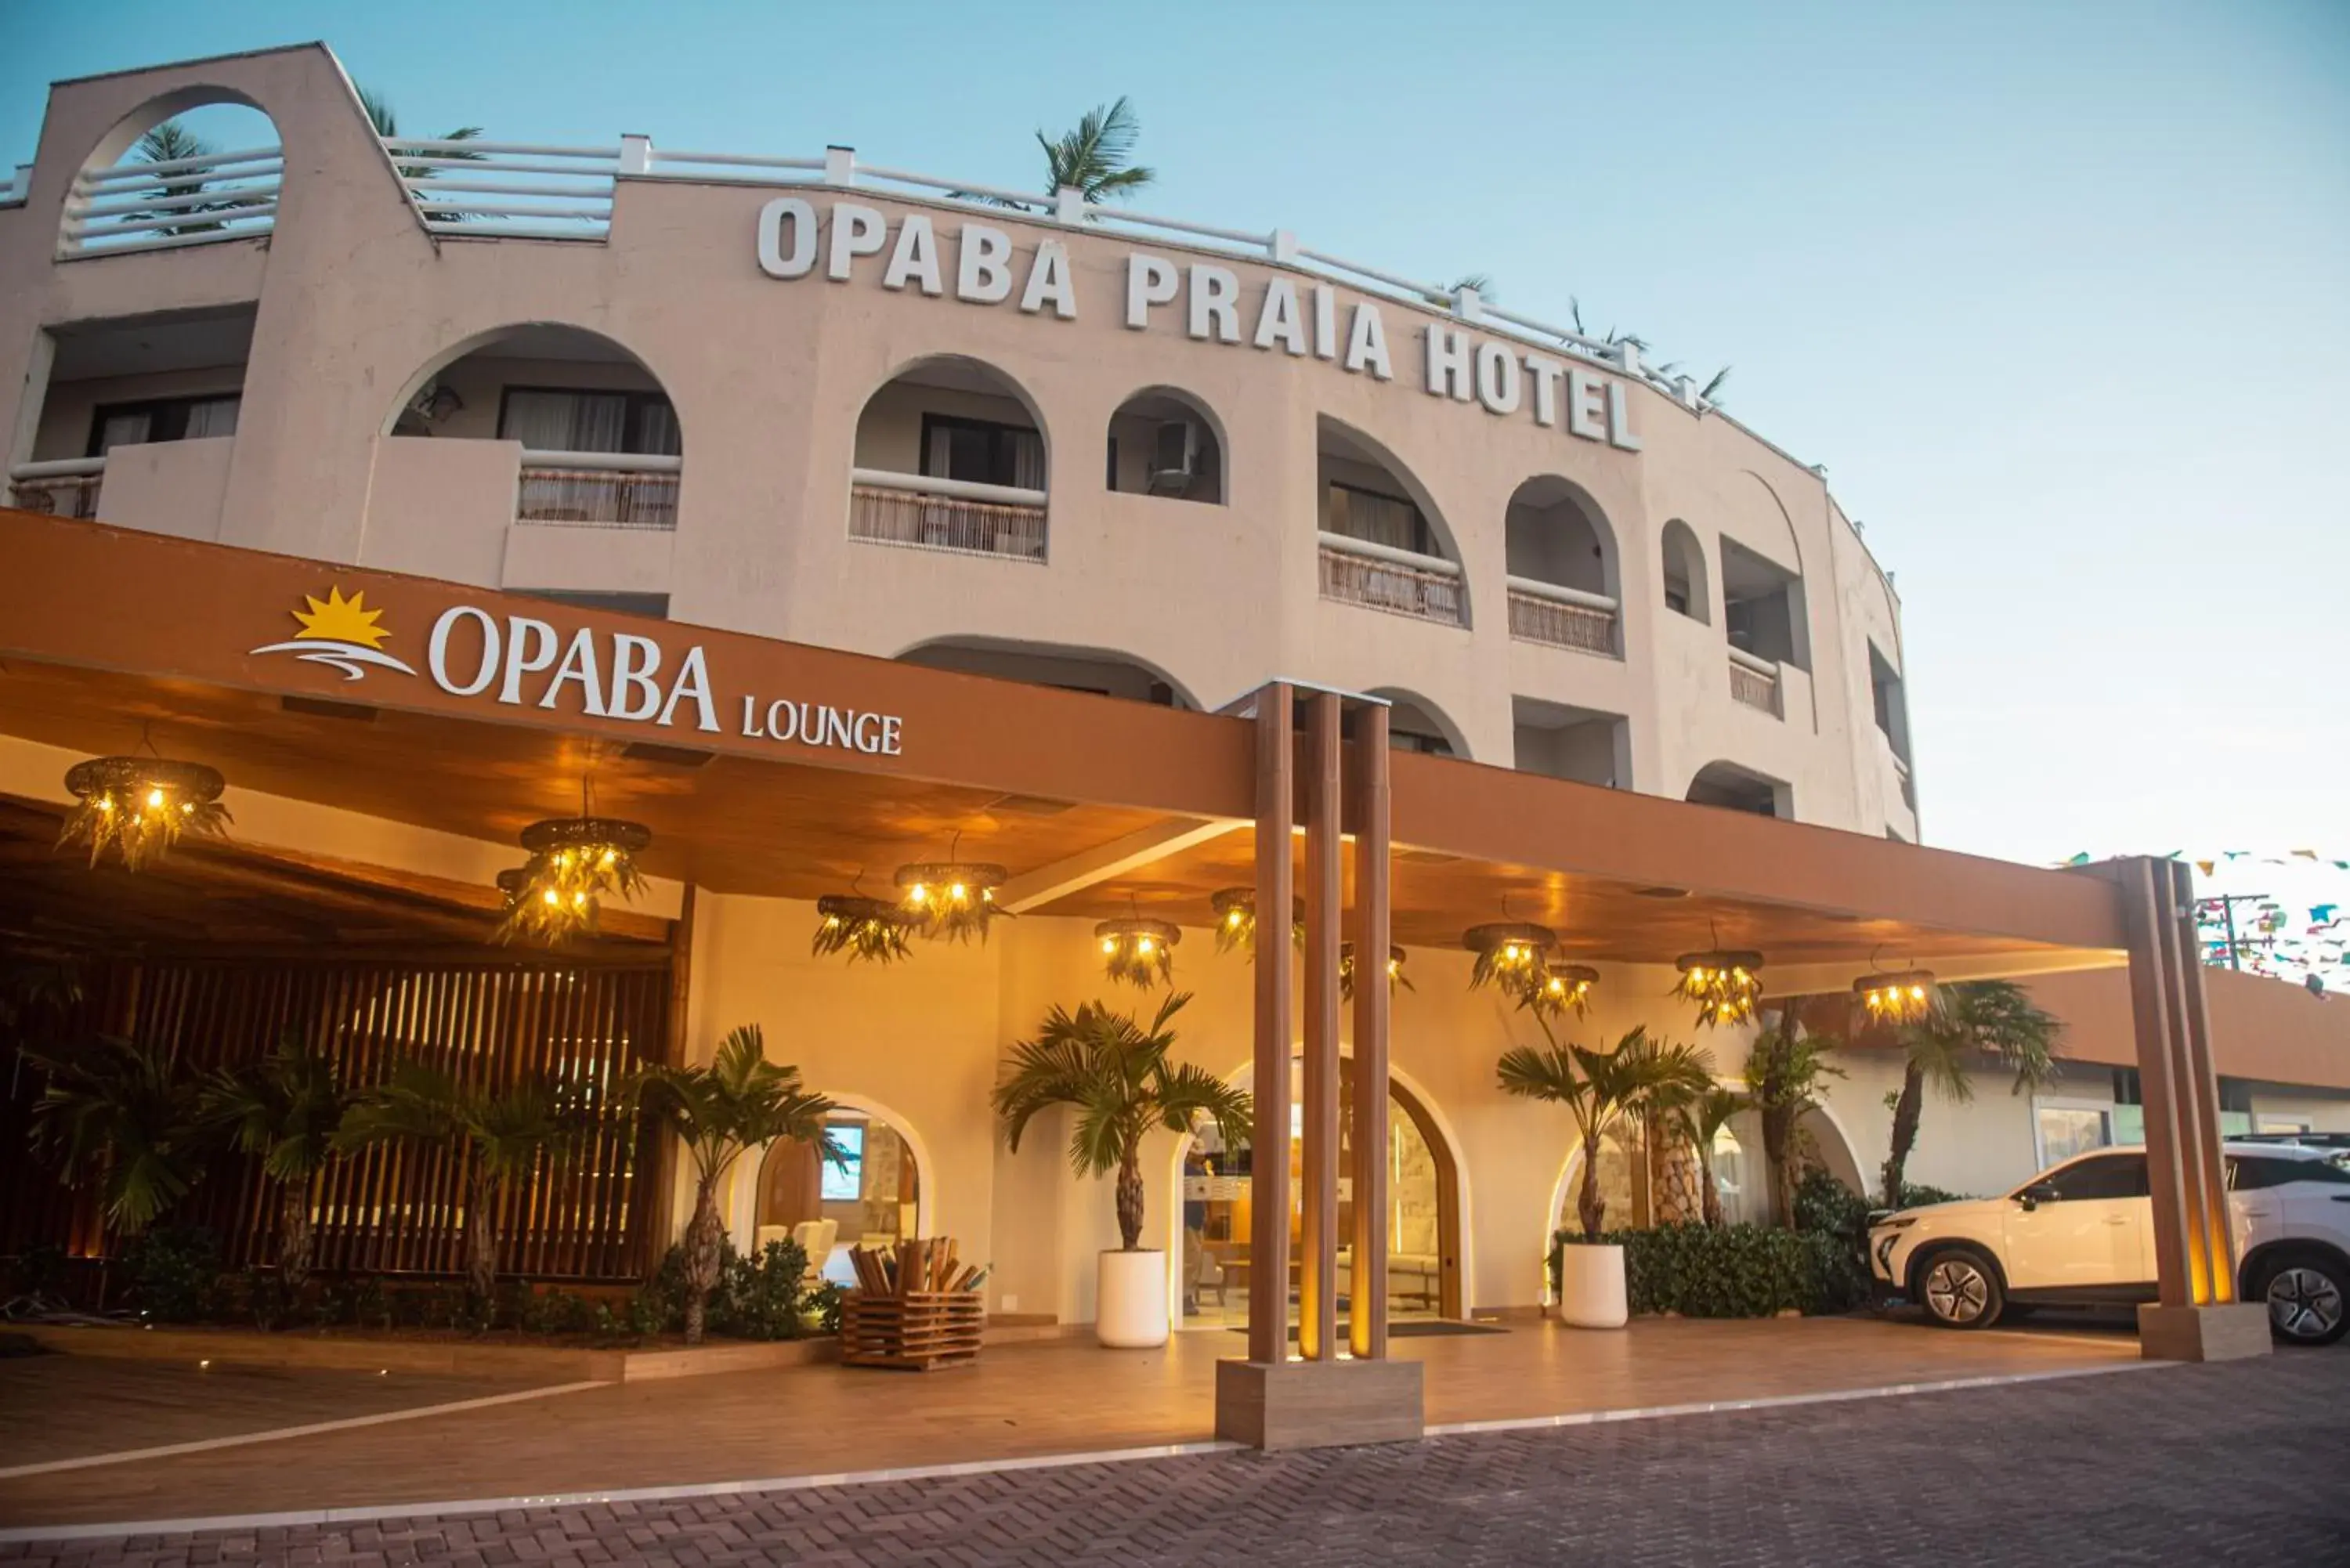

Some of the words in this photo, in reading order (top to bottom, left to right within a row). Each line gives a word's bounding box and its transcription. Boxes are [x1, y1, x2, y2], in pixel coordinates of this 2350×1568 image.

[757, 197, 1077, 320] OPABA
[1126, 252, 1394, 381] PRAIA
[1427, 323, 1641, 452] HOTEL
[428, 605, 721, 732] OPABA
[742, 695, 902, 756] LOUNGE
